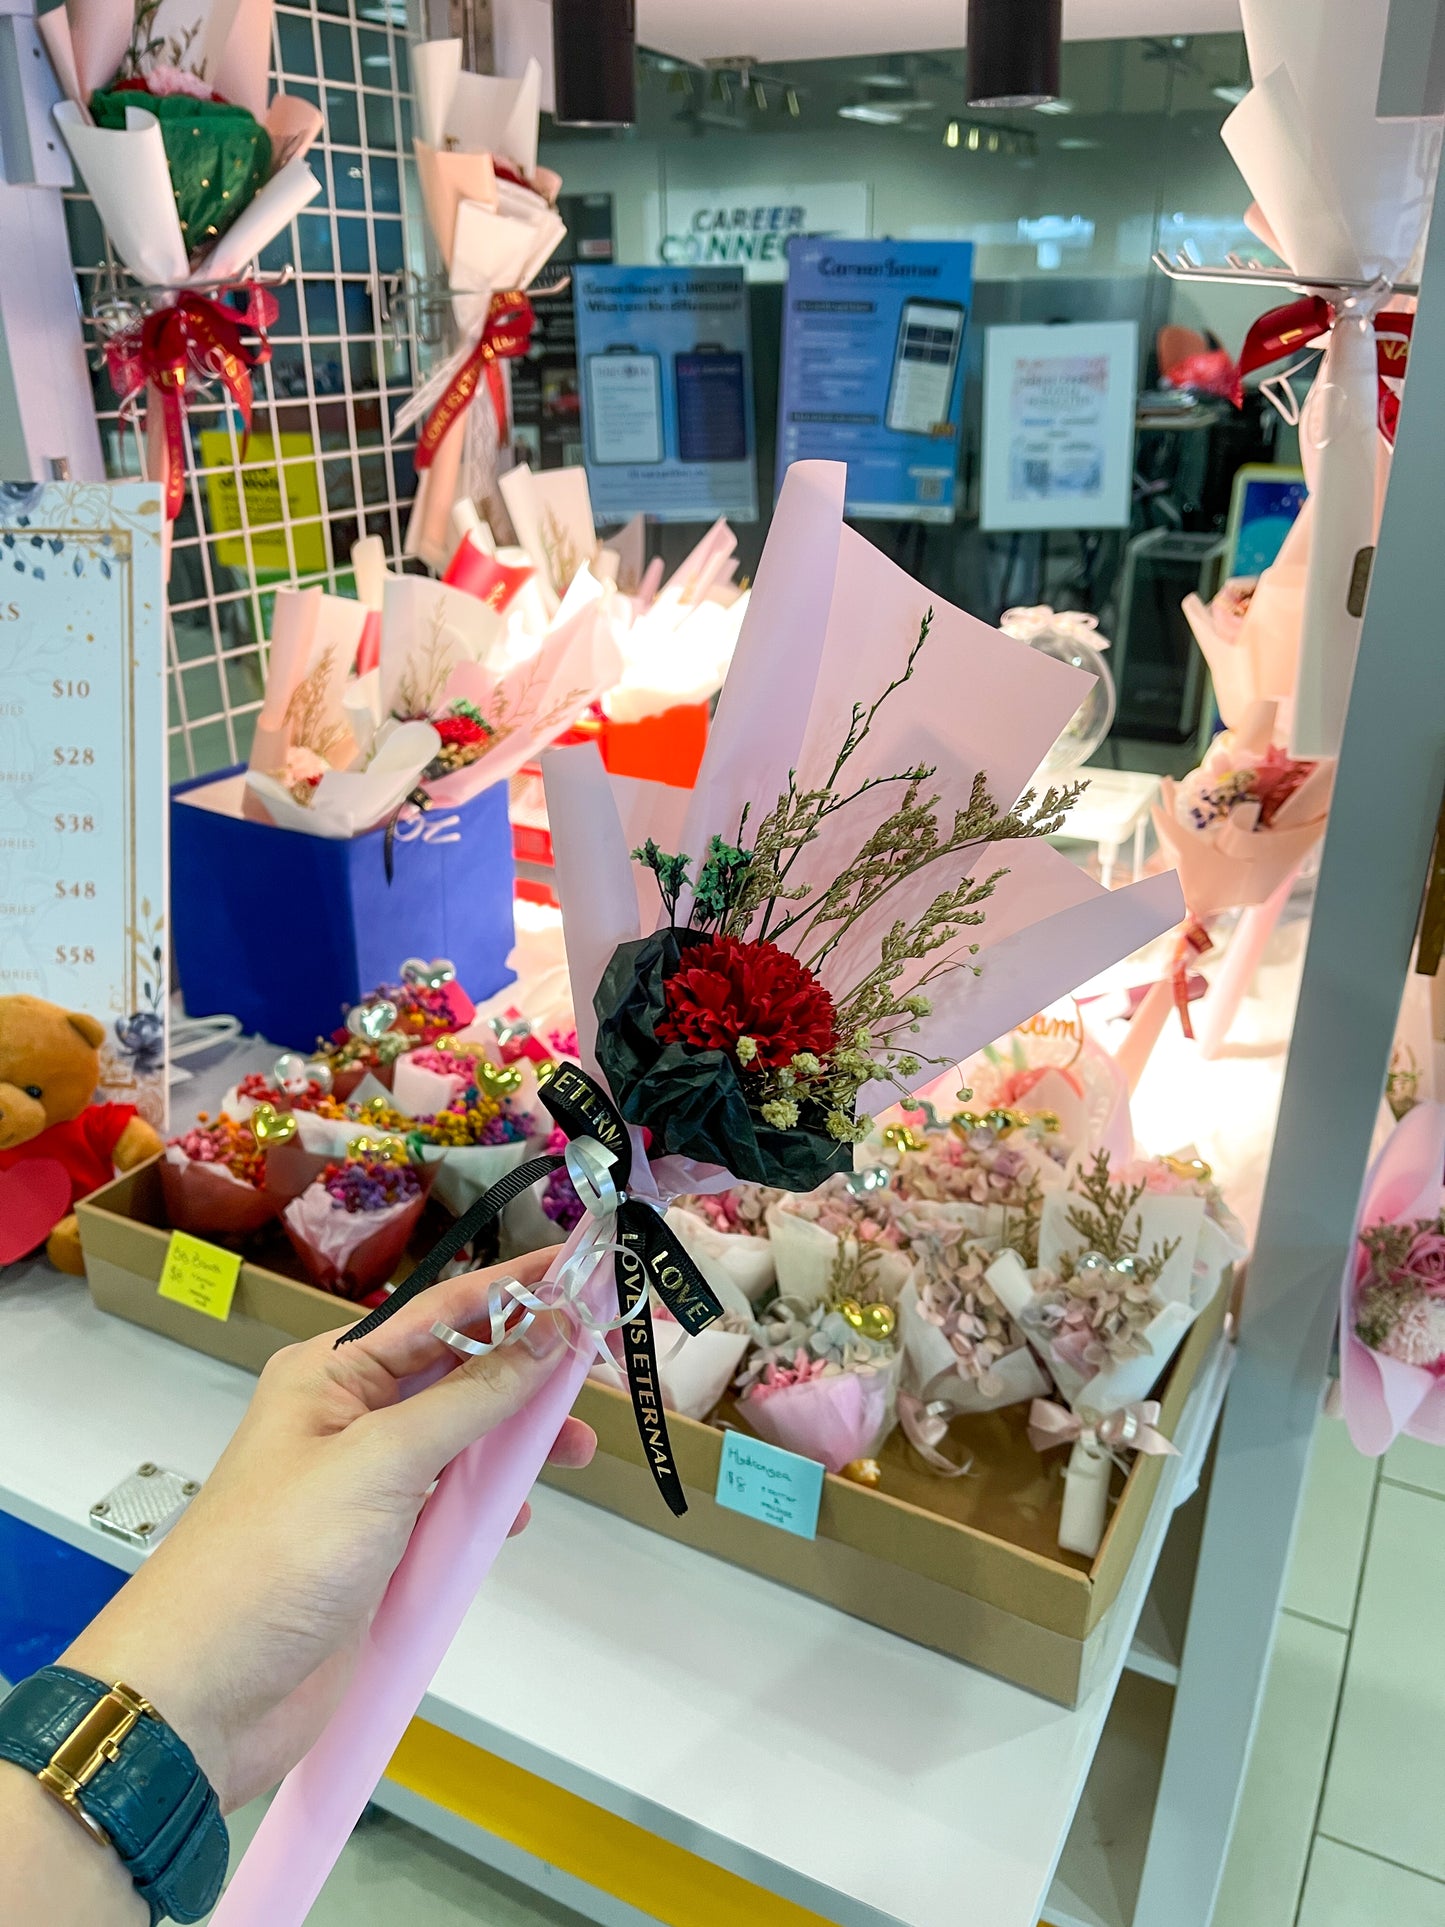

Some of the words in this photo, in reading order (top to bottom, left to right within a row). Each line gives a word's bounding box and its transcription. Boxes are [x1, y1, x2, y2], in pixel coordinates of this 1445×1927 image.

[692, 206, 807, 231] CAREER
[52, 678, 90, 698] $10
[53, 747, 95, 766] $28
[54, 813, 94, 832] $38
[55, 879, 96, 899] $48
[55, 945, 96, 964] $58
[651, 1250, 710, 1323] LOVE
[629, 1319, 648, 1344] IS
[633, 1353, 672, 1479] ETERNAL
